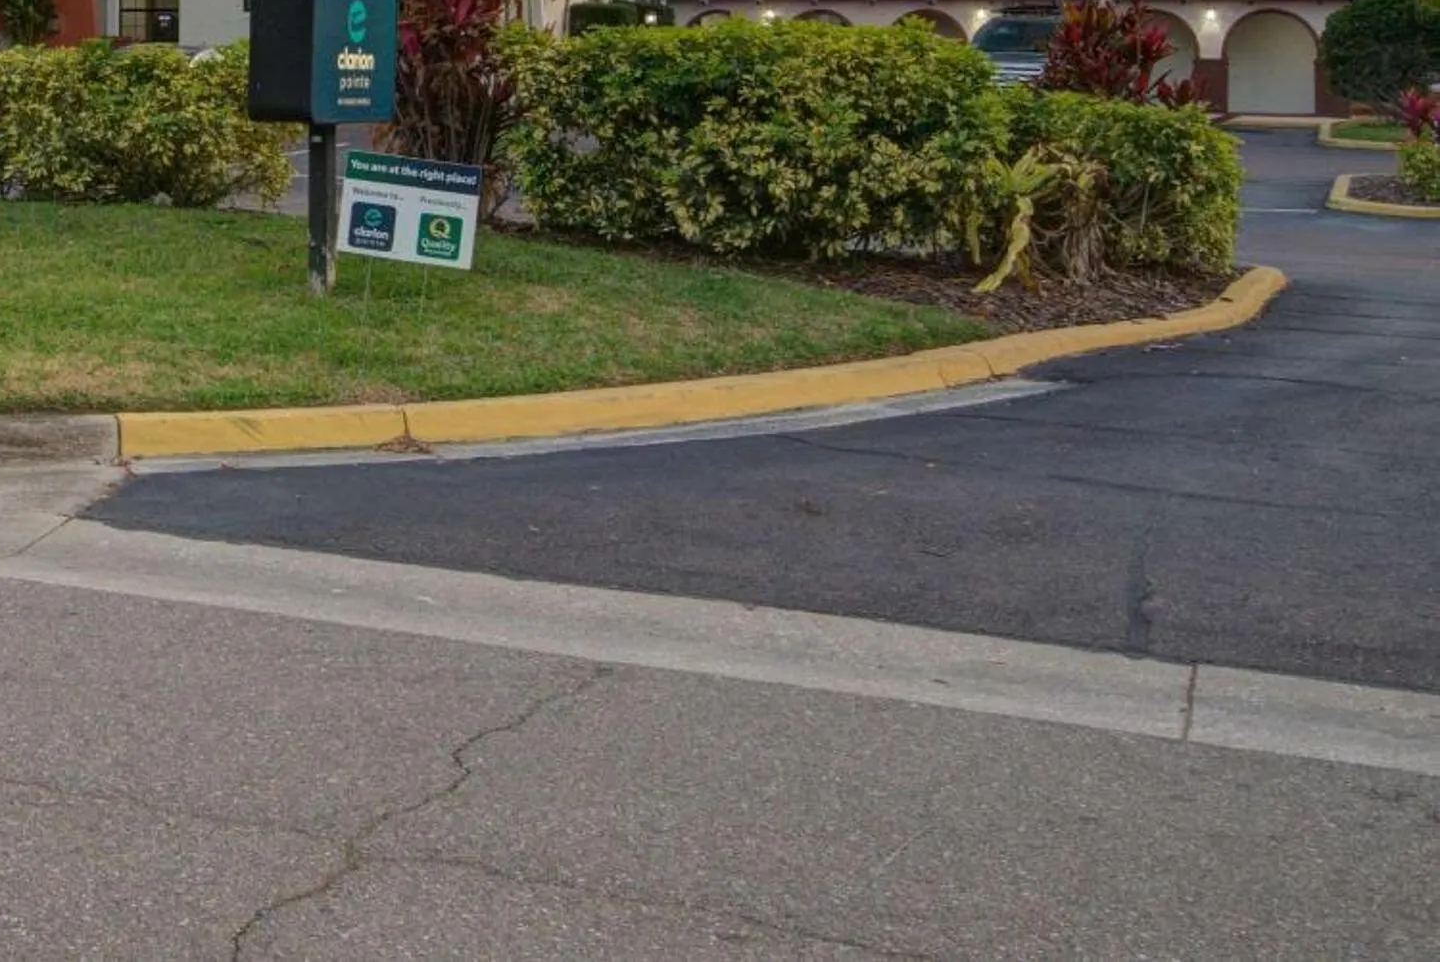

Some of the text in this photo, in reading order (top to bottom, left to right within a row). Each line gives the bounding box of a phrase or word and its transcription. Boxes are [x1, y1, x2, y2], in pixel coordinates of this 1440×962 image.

[337, 46, 375, 70] clarion
[351, 158, 477, 186] You are at the right place!
